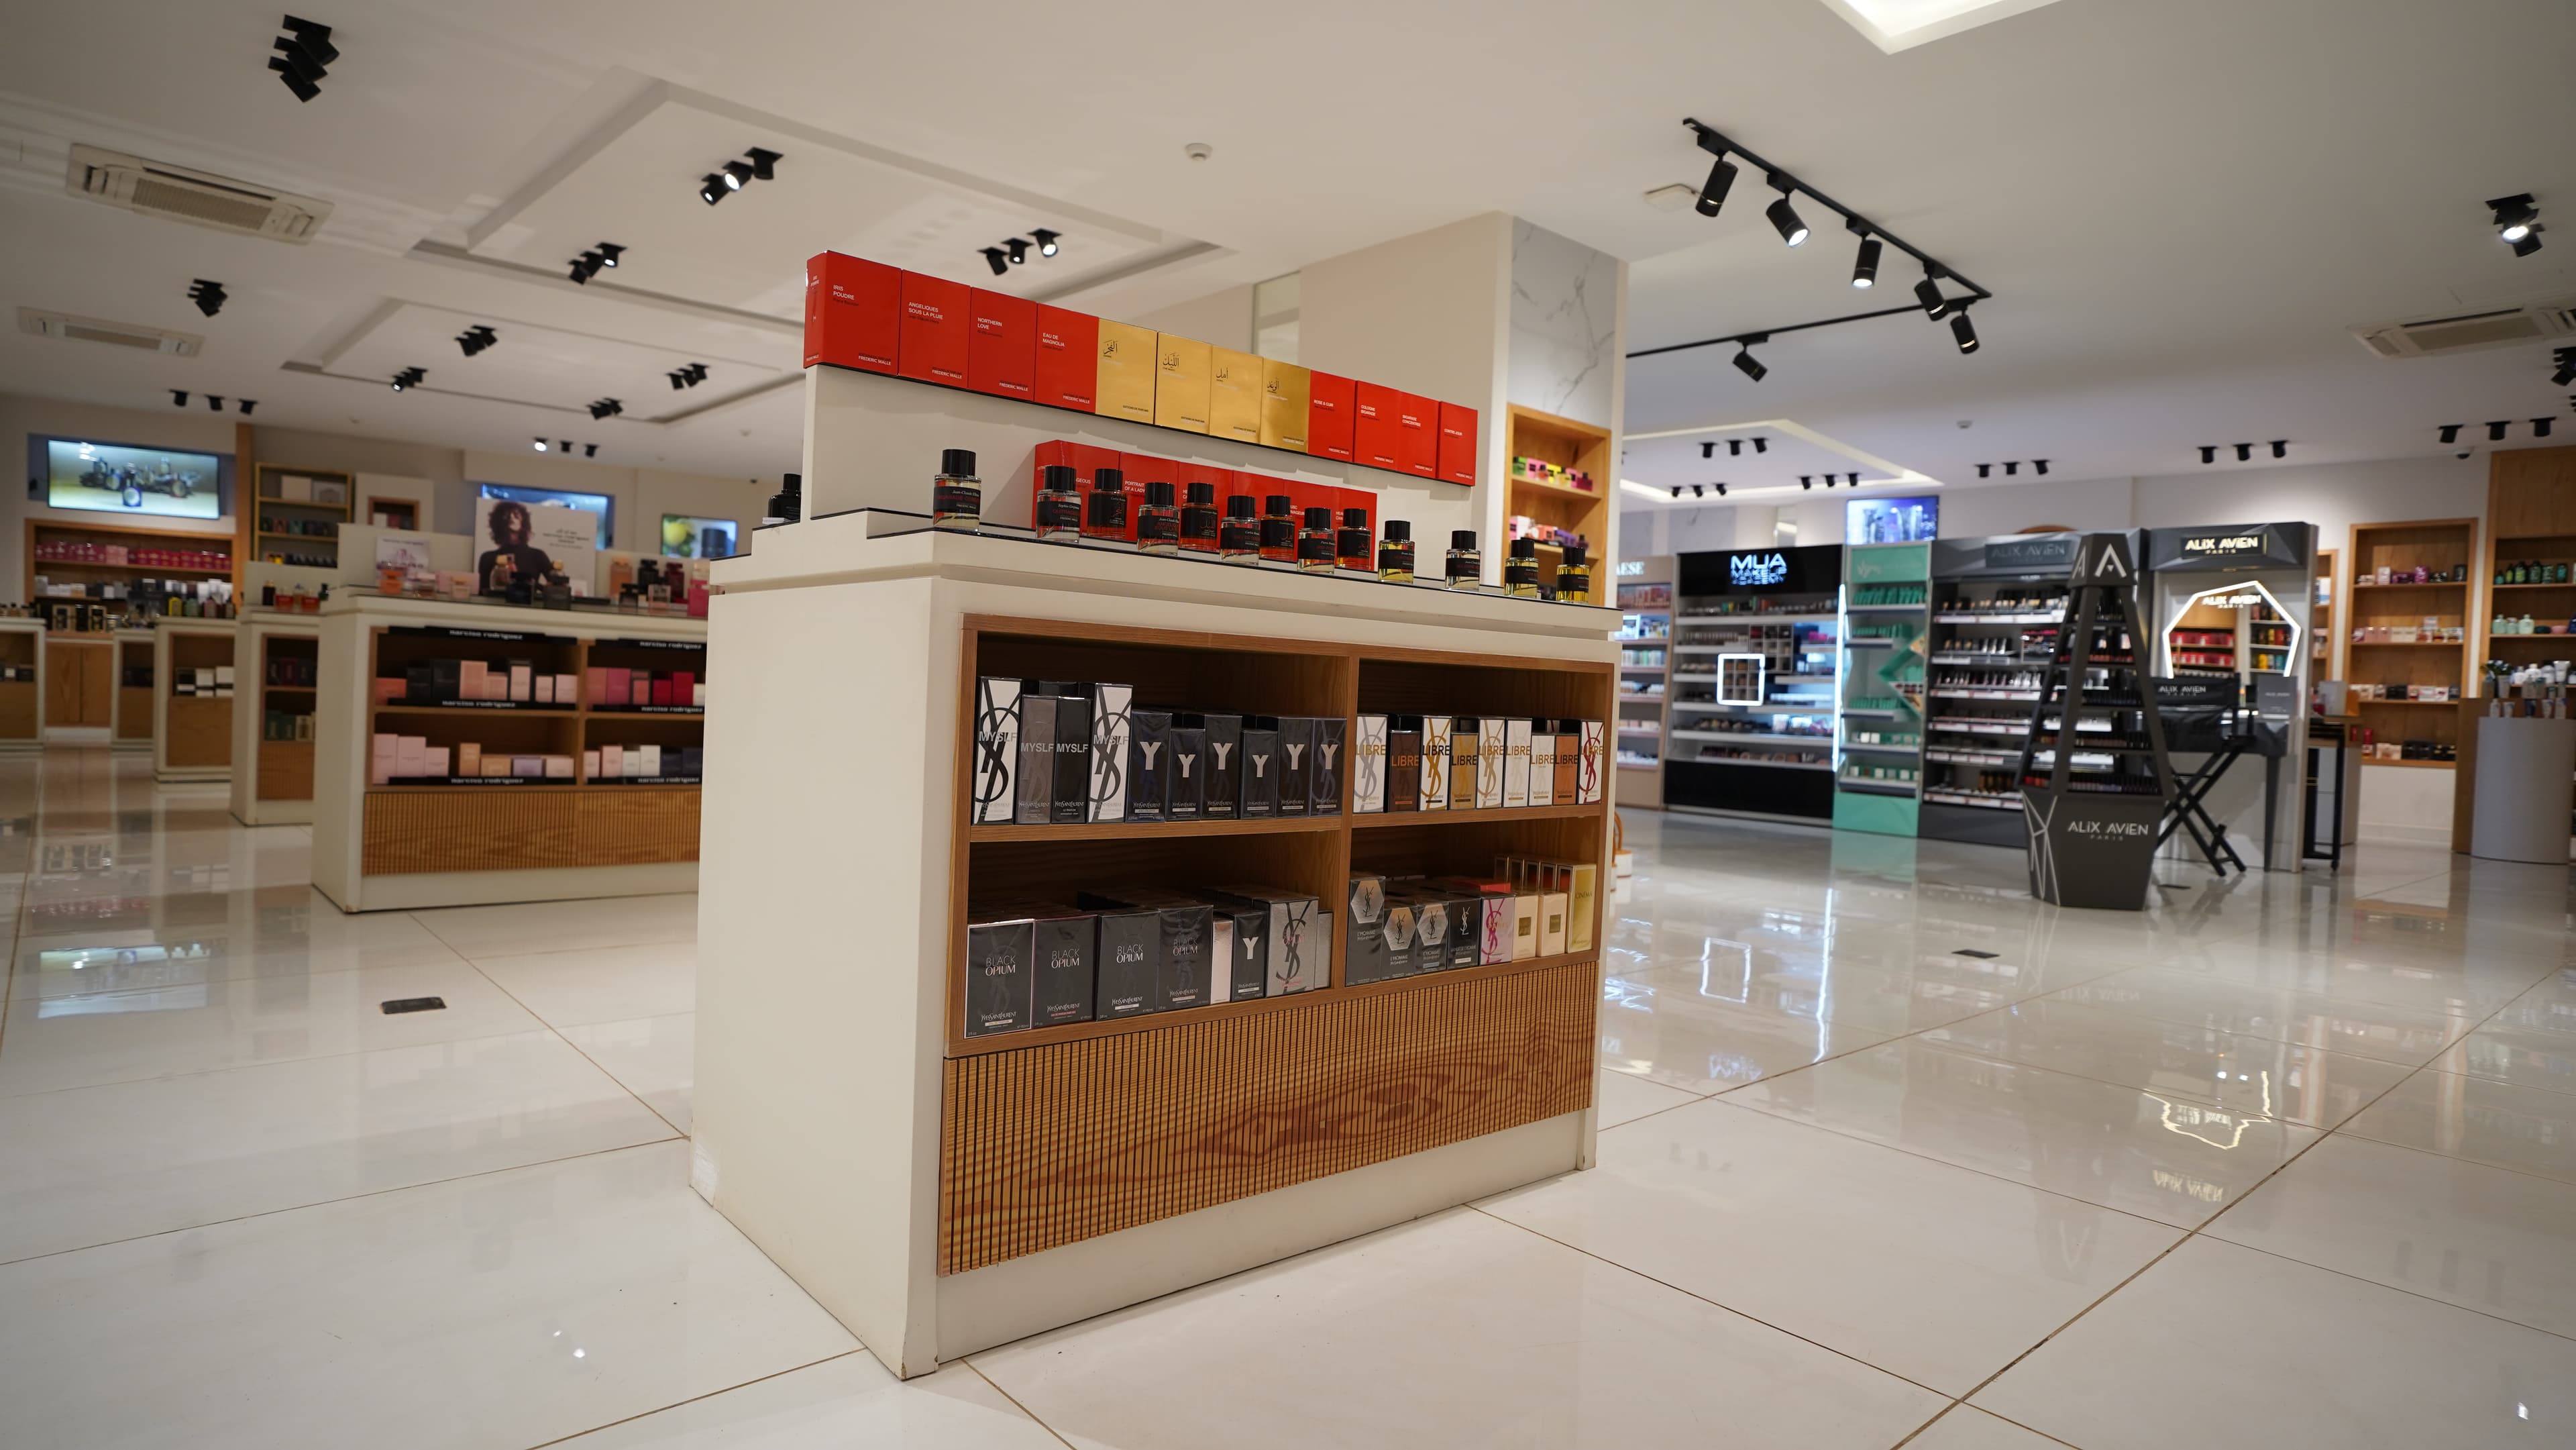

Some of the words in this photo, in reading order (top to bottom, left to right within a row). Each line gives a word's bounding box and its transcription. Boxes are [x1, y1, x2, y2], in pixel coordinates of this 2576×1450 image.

[833, 291, 855, 300] POUDRE
[908, 302, 938, 313] ANGELIQUES
[977, 317, 1002, 327] NORTHERN
[1042, 338, 1065, 347] MAGNOLIA
[1730, 553, 1786, 570] MUA
[1616, 561, 1644, 576] AESE
[979, 731, 1018, 743] MYSLF
[1093, 735, 1128, 745] MYSLF
[1020, 743, 1054, 752] MYSLF
[1057, 743, 1089, 753] MYSLF
[1356, 745, 1386, 756] LIBRE
[1423, 745, 1450, 756] LIBRE
[1479, 745, 1503, 756] LIBRE
[1507, 745, 1530, 756] LIBRE
[1581, 746, 1603, 756] LIBRE
[1140, 741, 1161, 770] Y
[1213, 743, 1233, 770] Y
[1286, 744, 1305, 770] Y
[1321, 744, 1338, 770] Y
[1391, 756, 1419, 766] LIBRE
[1452, 756, 1477, 766] LIBRE
[1530, 754, 1554, 764] LIBRE
[1556, 755, 1578, 764] LIBRE
[1178, 754, 1196, 778] Y
[1252, 755, 1269, 778] Y
[1173, 937, 1197, 947] BLACK
[1117, 943, 1144, 955] BLACK
[1173, 945, 1197, 956] OPIUM
[1242, 936, 1259, 960] Y
[1052, 948, 1079, 960] BLACK
[1116, 952, 1143, 964] OPIUM
[986, 955, 1016, 967] BLACK
[1051, 957, 1079, 969] OPIUM
[985, 964, 1016, 976] OPIUM
